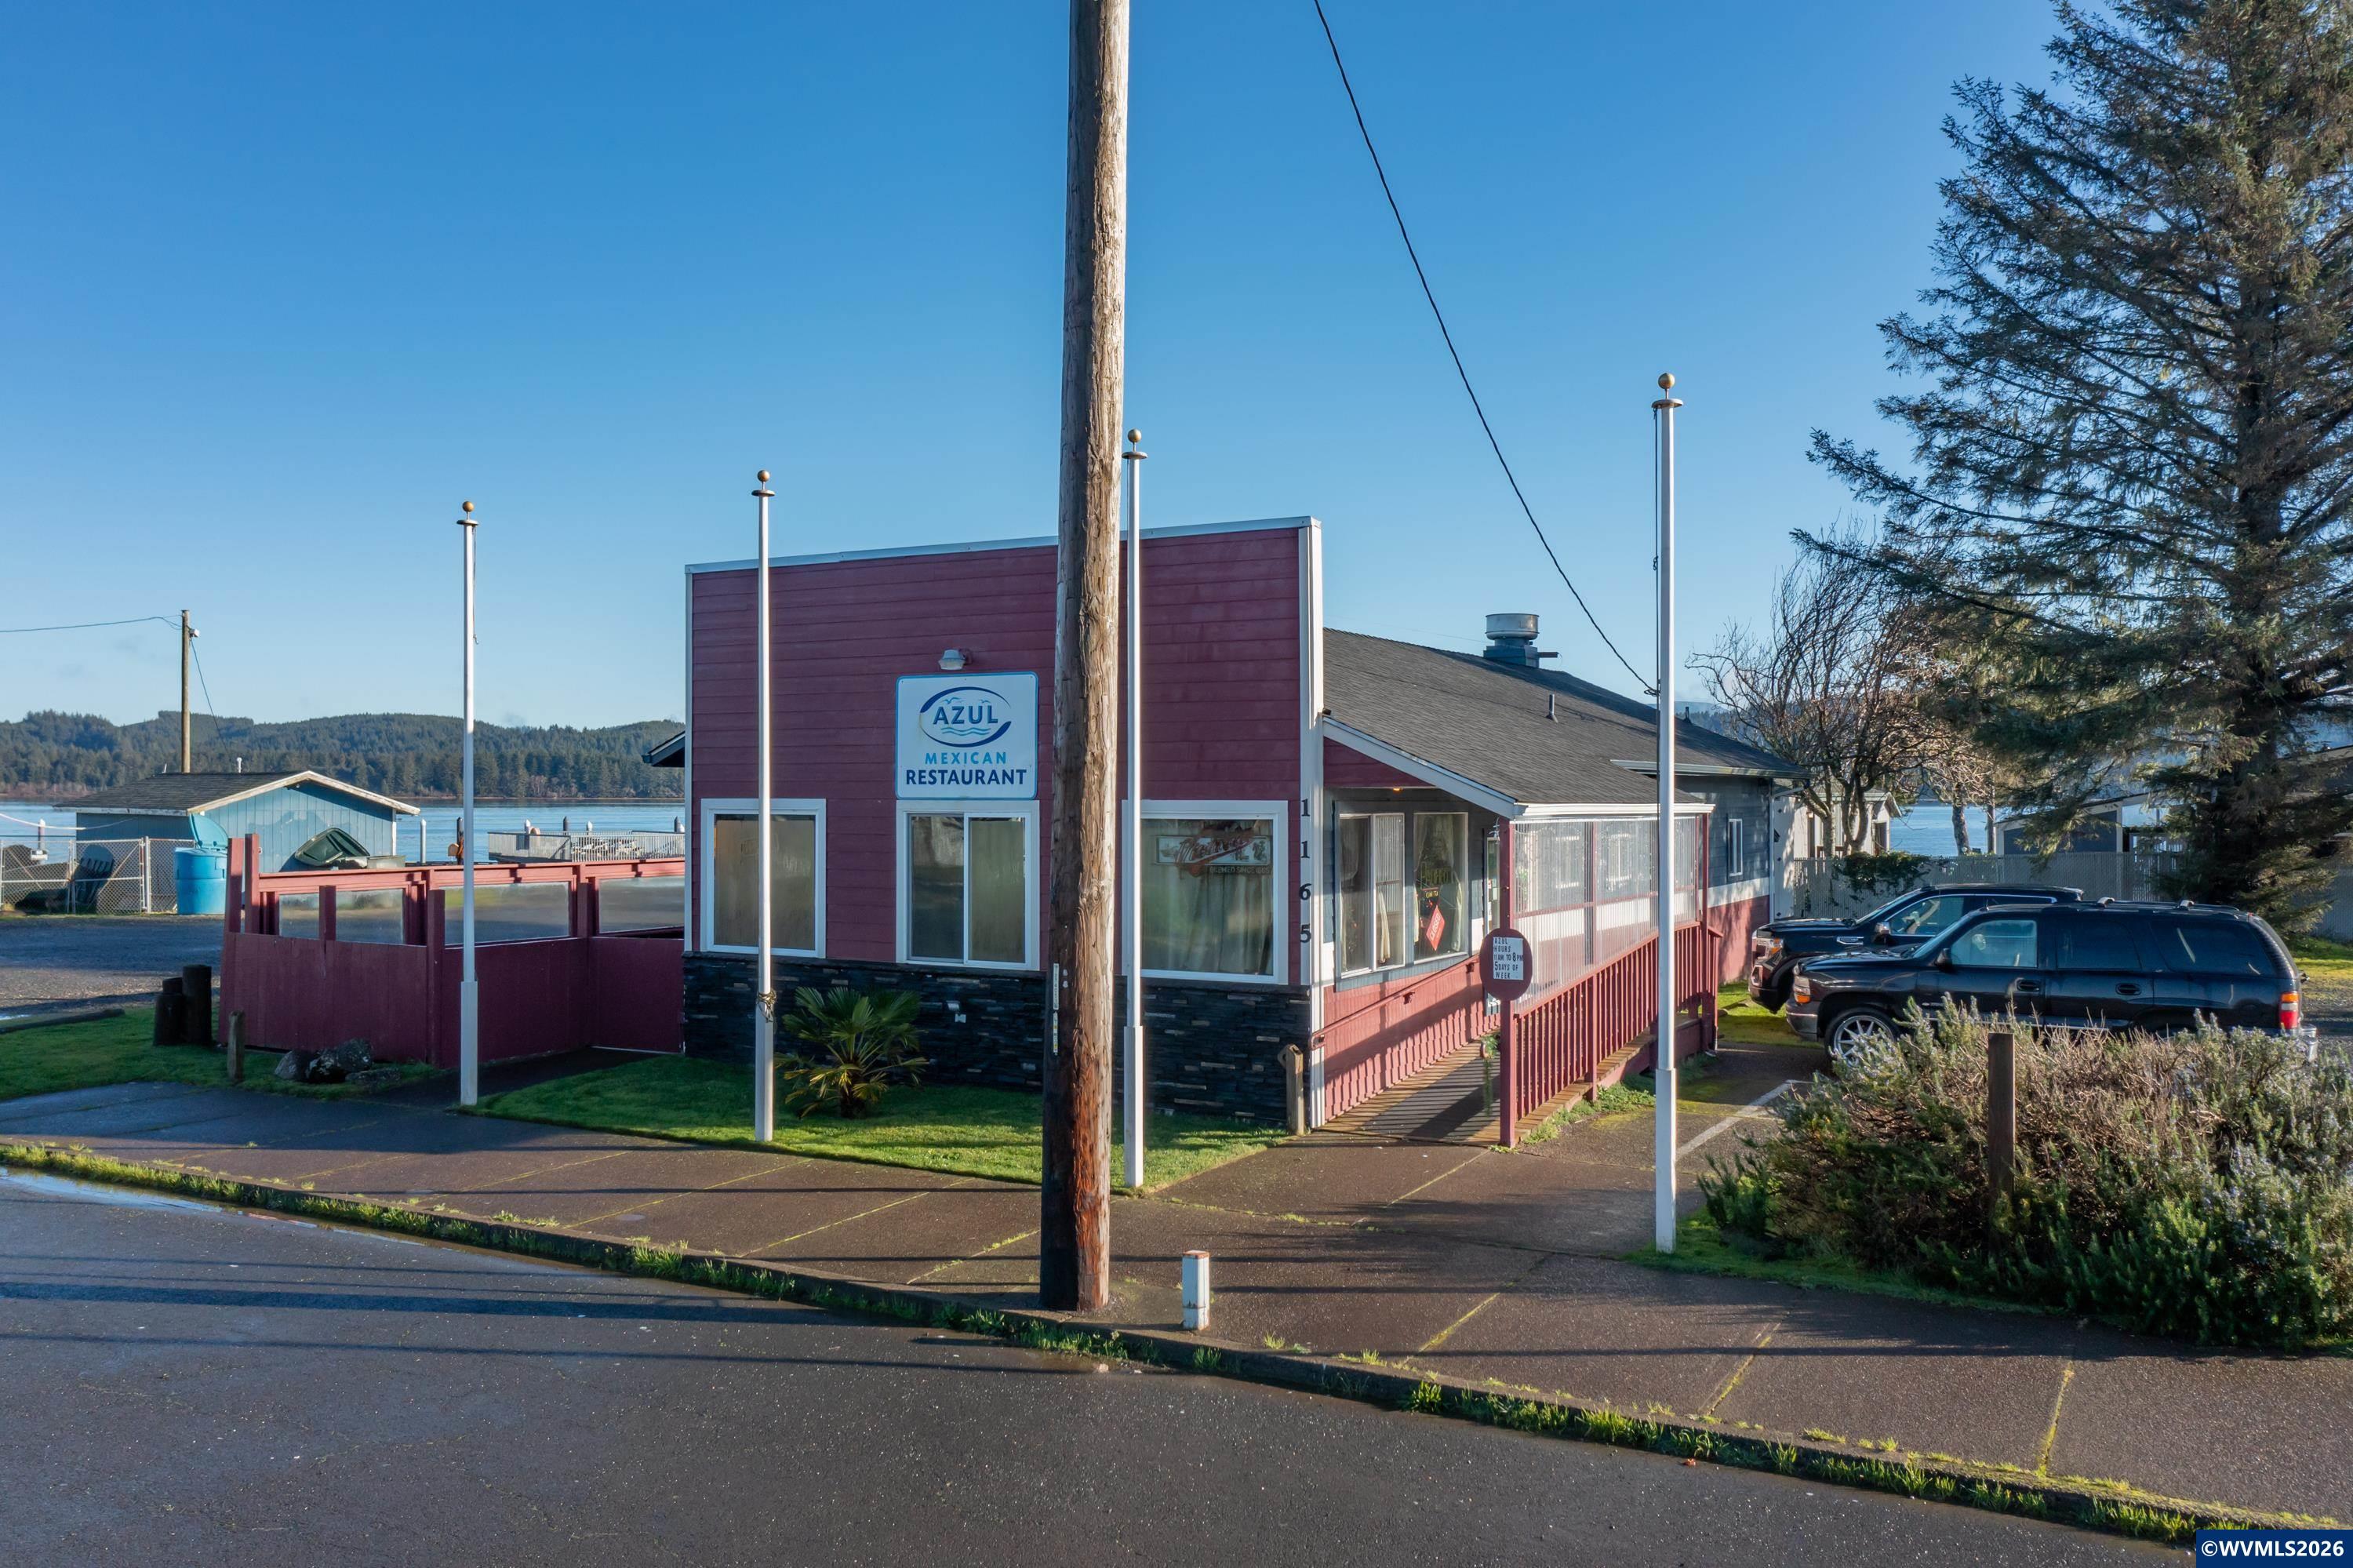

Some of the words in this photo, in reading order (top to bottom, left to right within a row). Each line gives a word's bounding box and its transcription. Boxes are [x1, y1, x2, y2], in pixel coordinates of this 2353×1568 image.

[933, 706, 998, 725] AZUL
[925, 751, 1006, 765] MEXICAN
[906, 769, 1027, 785] RESTAURANT
